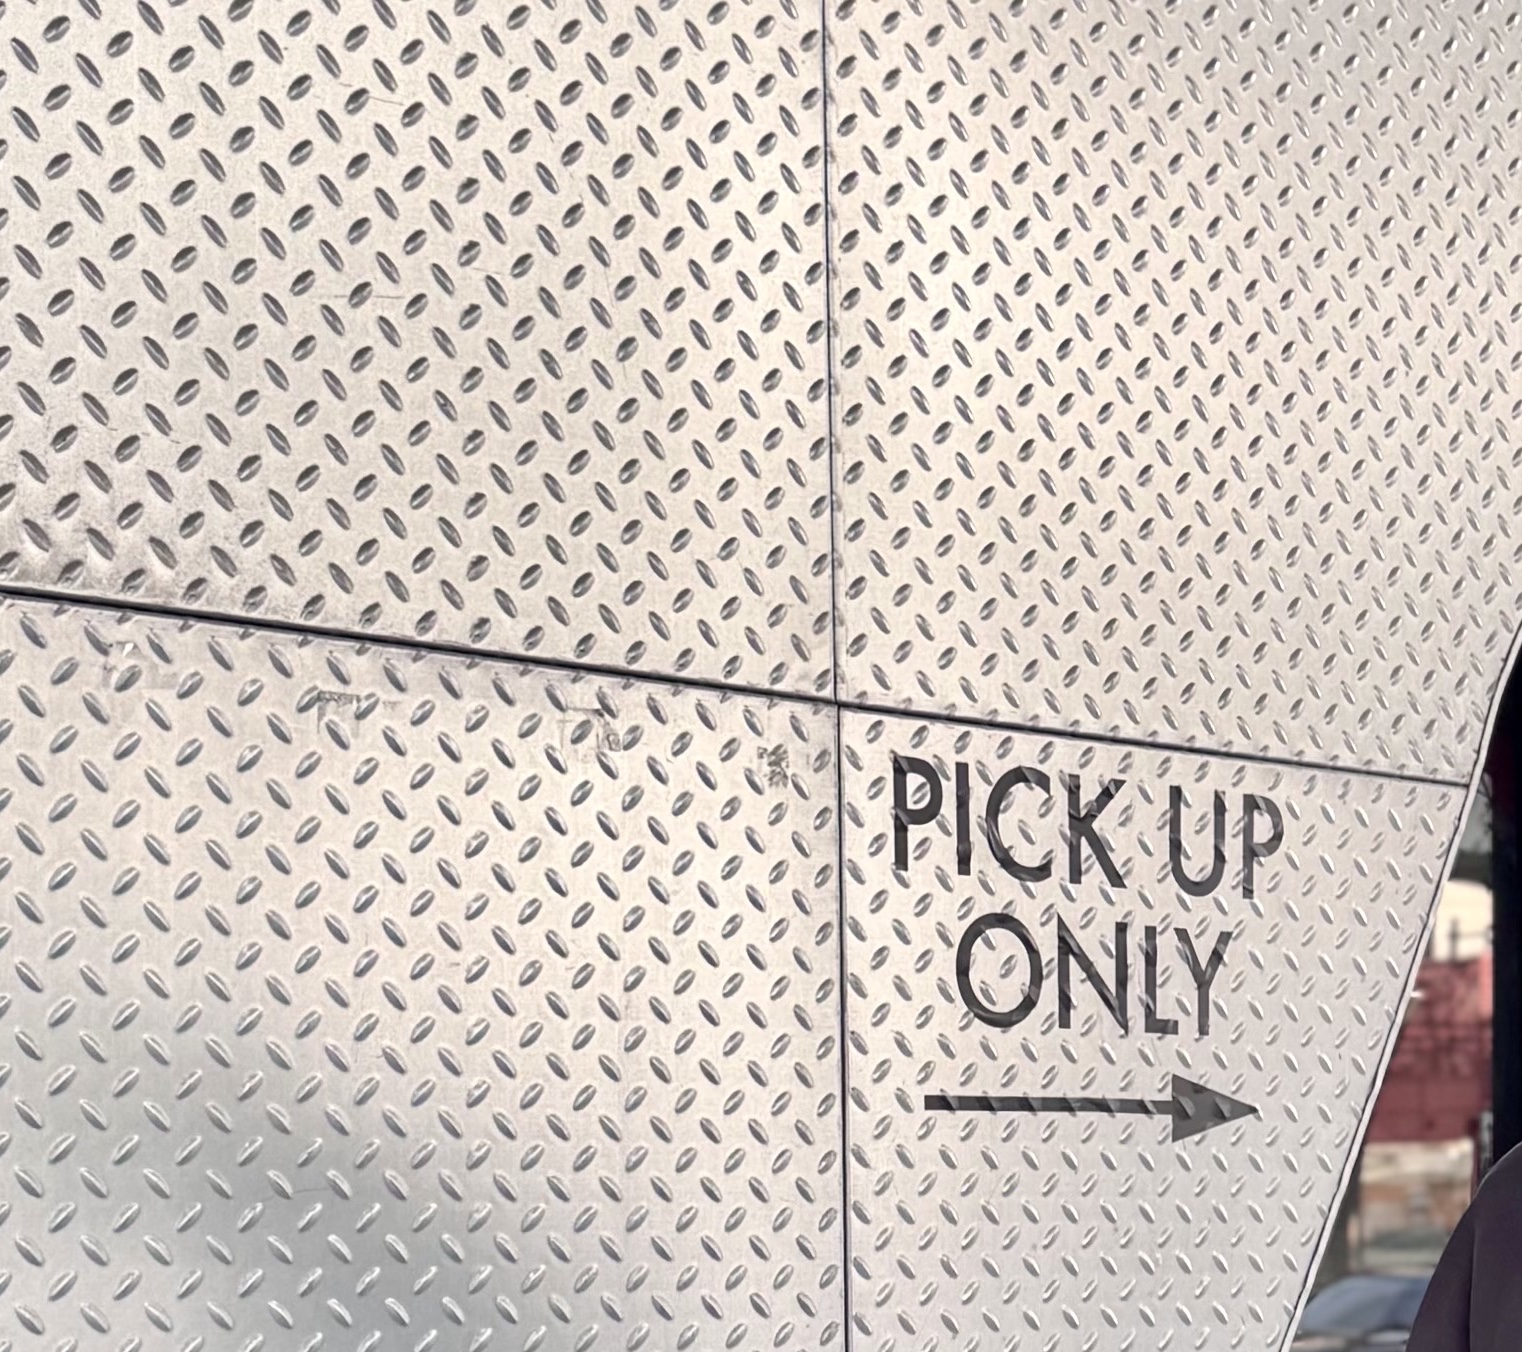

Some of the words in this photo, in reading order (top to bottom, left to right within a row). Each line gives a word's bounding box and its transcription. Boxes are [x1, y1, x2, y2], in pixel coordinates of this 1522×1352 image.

[892, 752, 1128, 889] PICK
[1168, 784, 1285, 900] UP
[955, 911, 1234, 1036] ONLY
